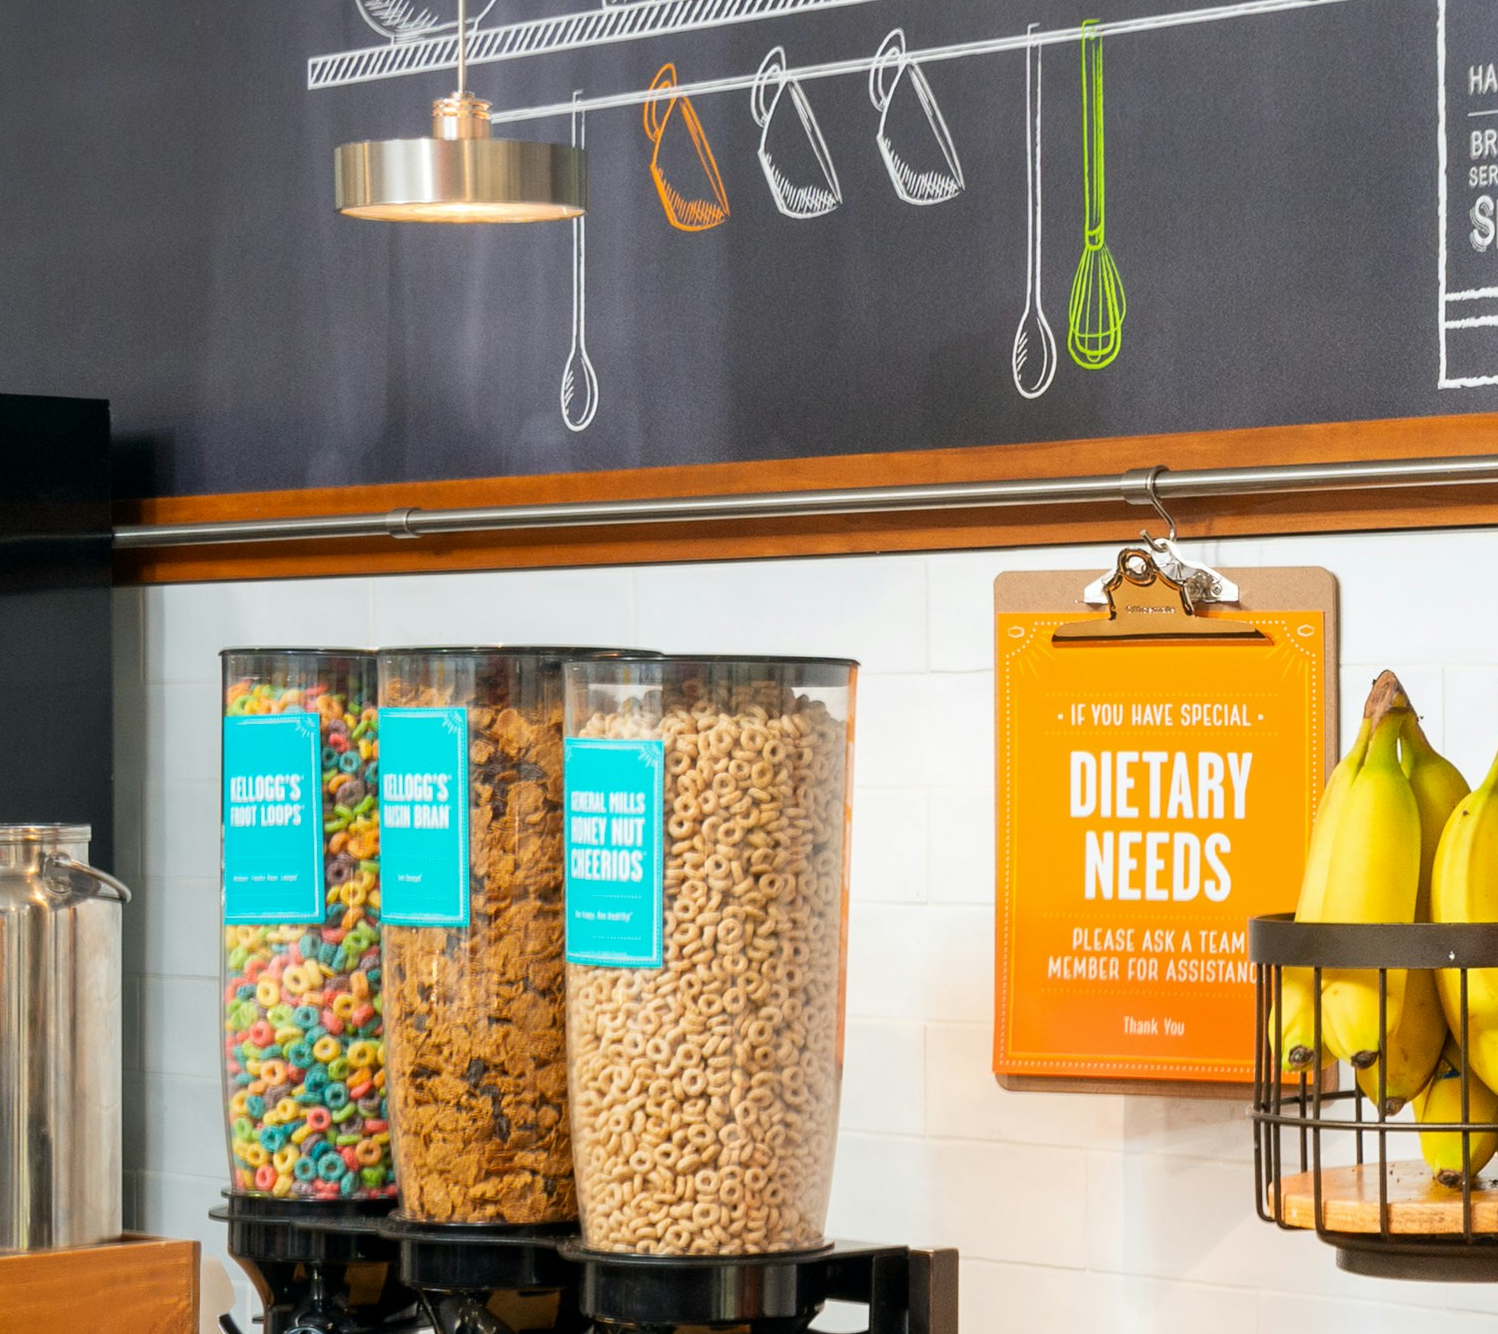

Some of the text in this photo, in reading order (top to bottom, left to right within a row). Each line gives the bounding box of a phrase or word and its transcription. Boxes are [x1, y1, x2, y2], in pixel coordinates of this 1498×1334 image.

[1071, 704, 1251, 727] IF YOU HAVE SPECIAL
[230, 773, 302, 803] KELLOGG'S
[383, 772, 449, 802] KELLOGG'S
[1070, 750, 1253, 819] DIETARY
[261, 803, 302, 827] LOOPS
[413, 804, 450, 829] BRAN
[609, 791, 646, 814] MILLS
[611, 817, 645, 847] NUT
[571, 848, 644, 883] CHEERIOS
[1085, 830, 1232, 902] NEEDS
[1072, 927, 1245, 954] PLEASE ASK A TEAM
[1048, 955, 1266, 984] MEMBER FOR ASSISTANC
[1123, 1016, 1185, 1036] Thank You
